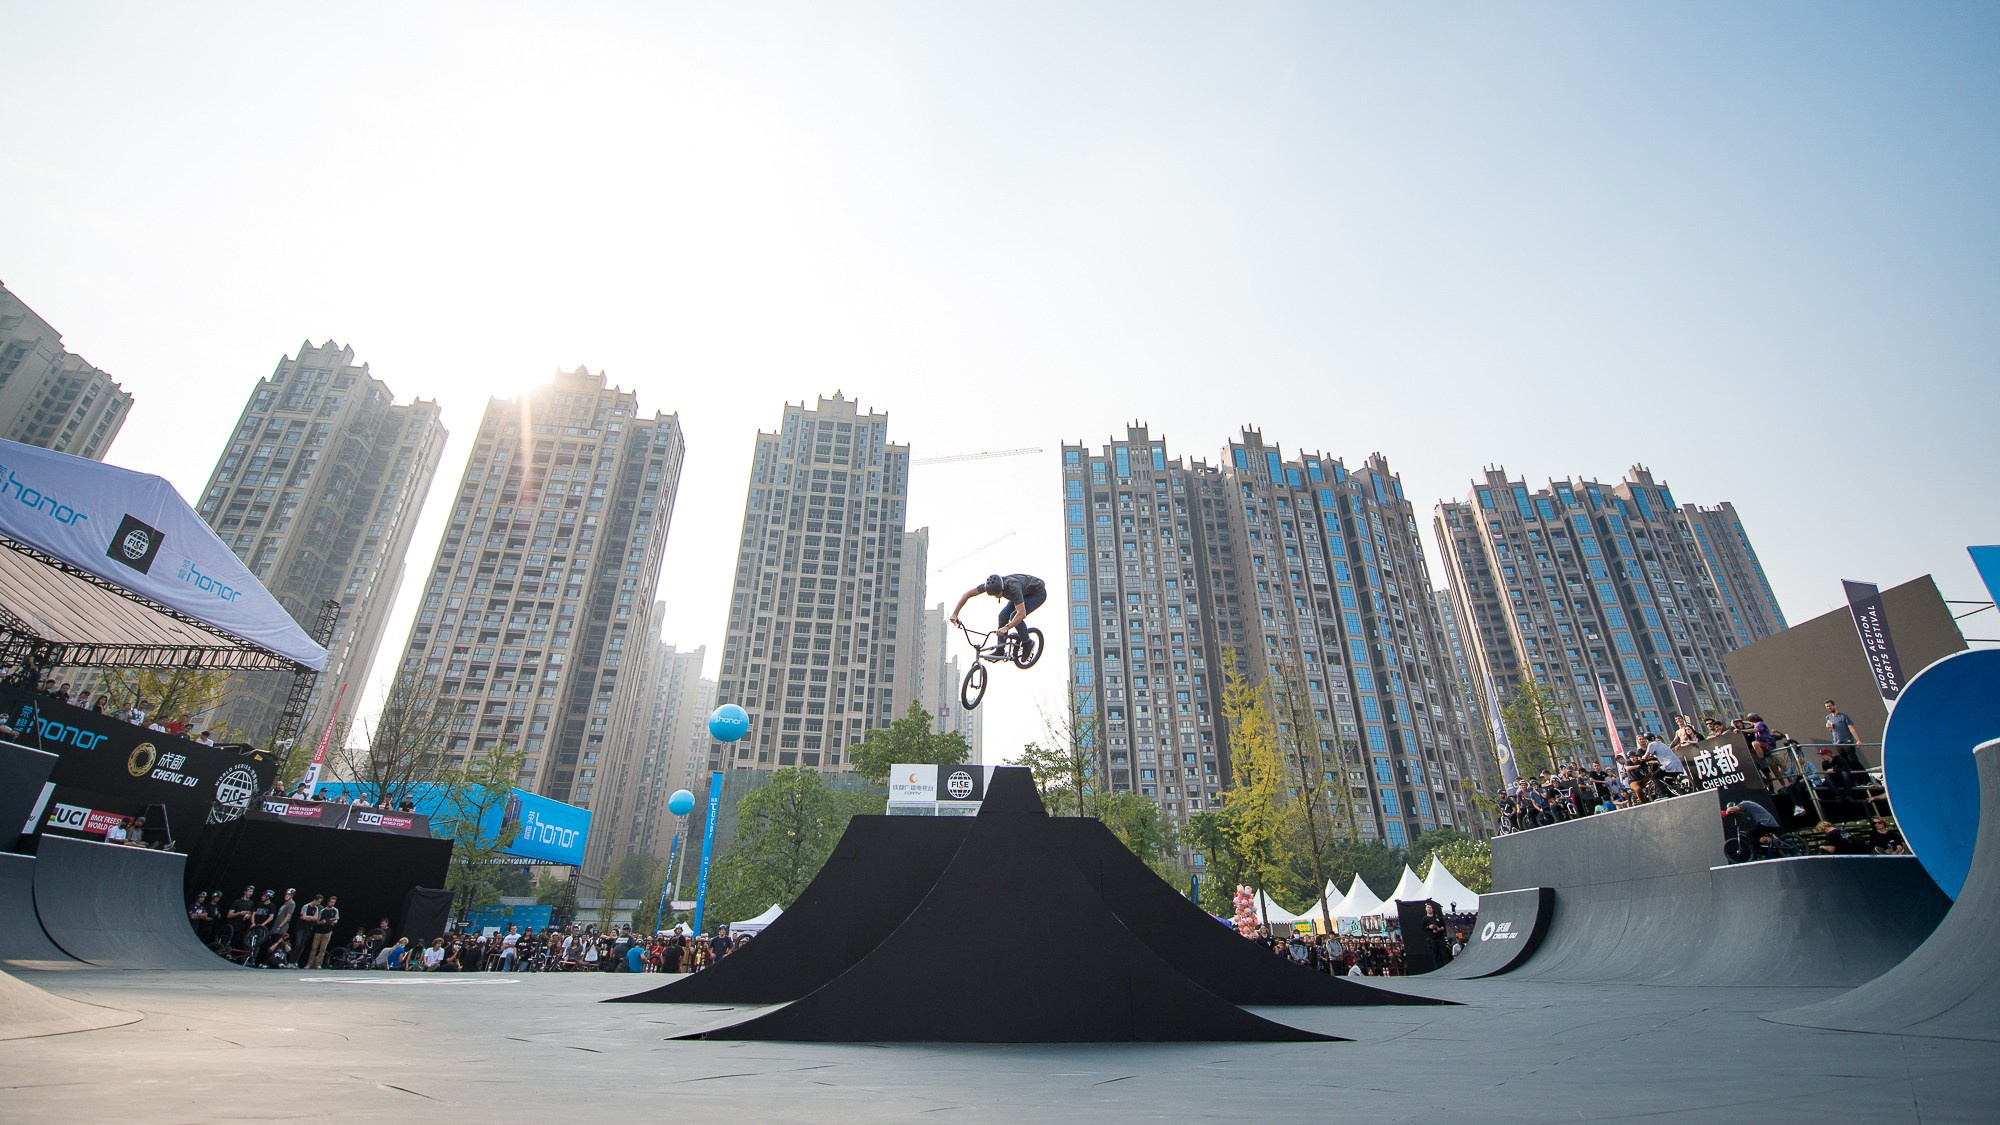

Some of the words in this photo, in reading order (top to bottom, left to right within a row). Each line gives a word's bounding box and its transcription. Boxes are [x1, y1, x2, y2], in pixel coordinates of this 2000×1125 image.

[1, 470, 88, 526] honor
[127, 538, 146, 550] FISE
[186, 563, 242, 602] honor
[1860, 615, 1877, 652] ACTION
[1868, 605, 1886, 650] FESTIVAL
[1873, 656, 1888, 689] WORLD
[1881, 653, 1899, 691] SPORTS
[26, 708, 109, 750] honor
[718, 716, 742, 725] honor
[158, 751, 186, 770] 成都
[1693, 743, 1739, 779] 成都
[151, 768, 184, 784] CHENG
[182, 776, 199, 787] DU
[951, 780, 970, 789] FISE
[1702, 771, 1745, 790] CHENGDU
[219, 788, 247, 805] FISE
[57, 807, 87, 826] UCI
[90, 813, 104, 822] BMX
[265, 804, 287, 814] UCI
[88, 821, 108, 831] WORLD
[362, 814, 381, 824] UCI
[532, 812, 580, 849] honor
